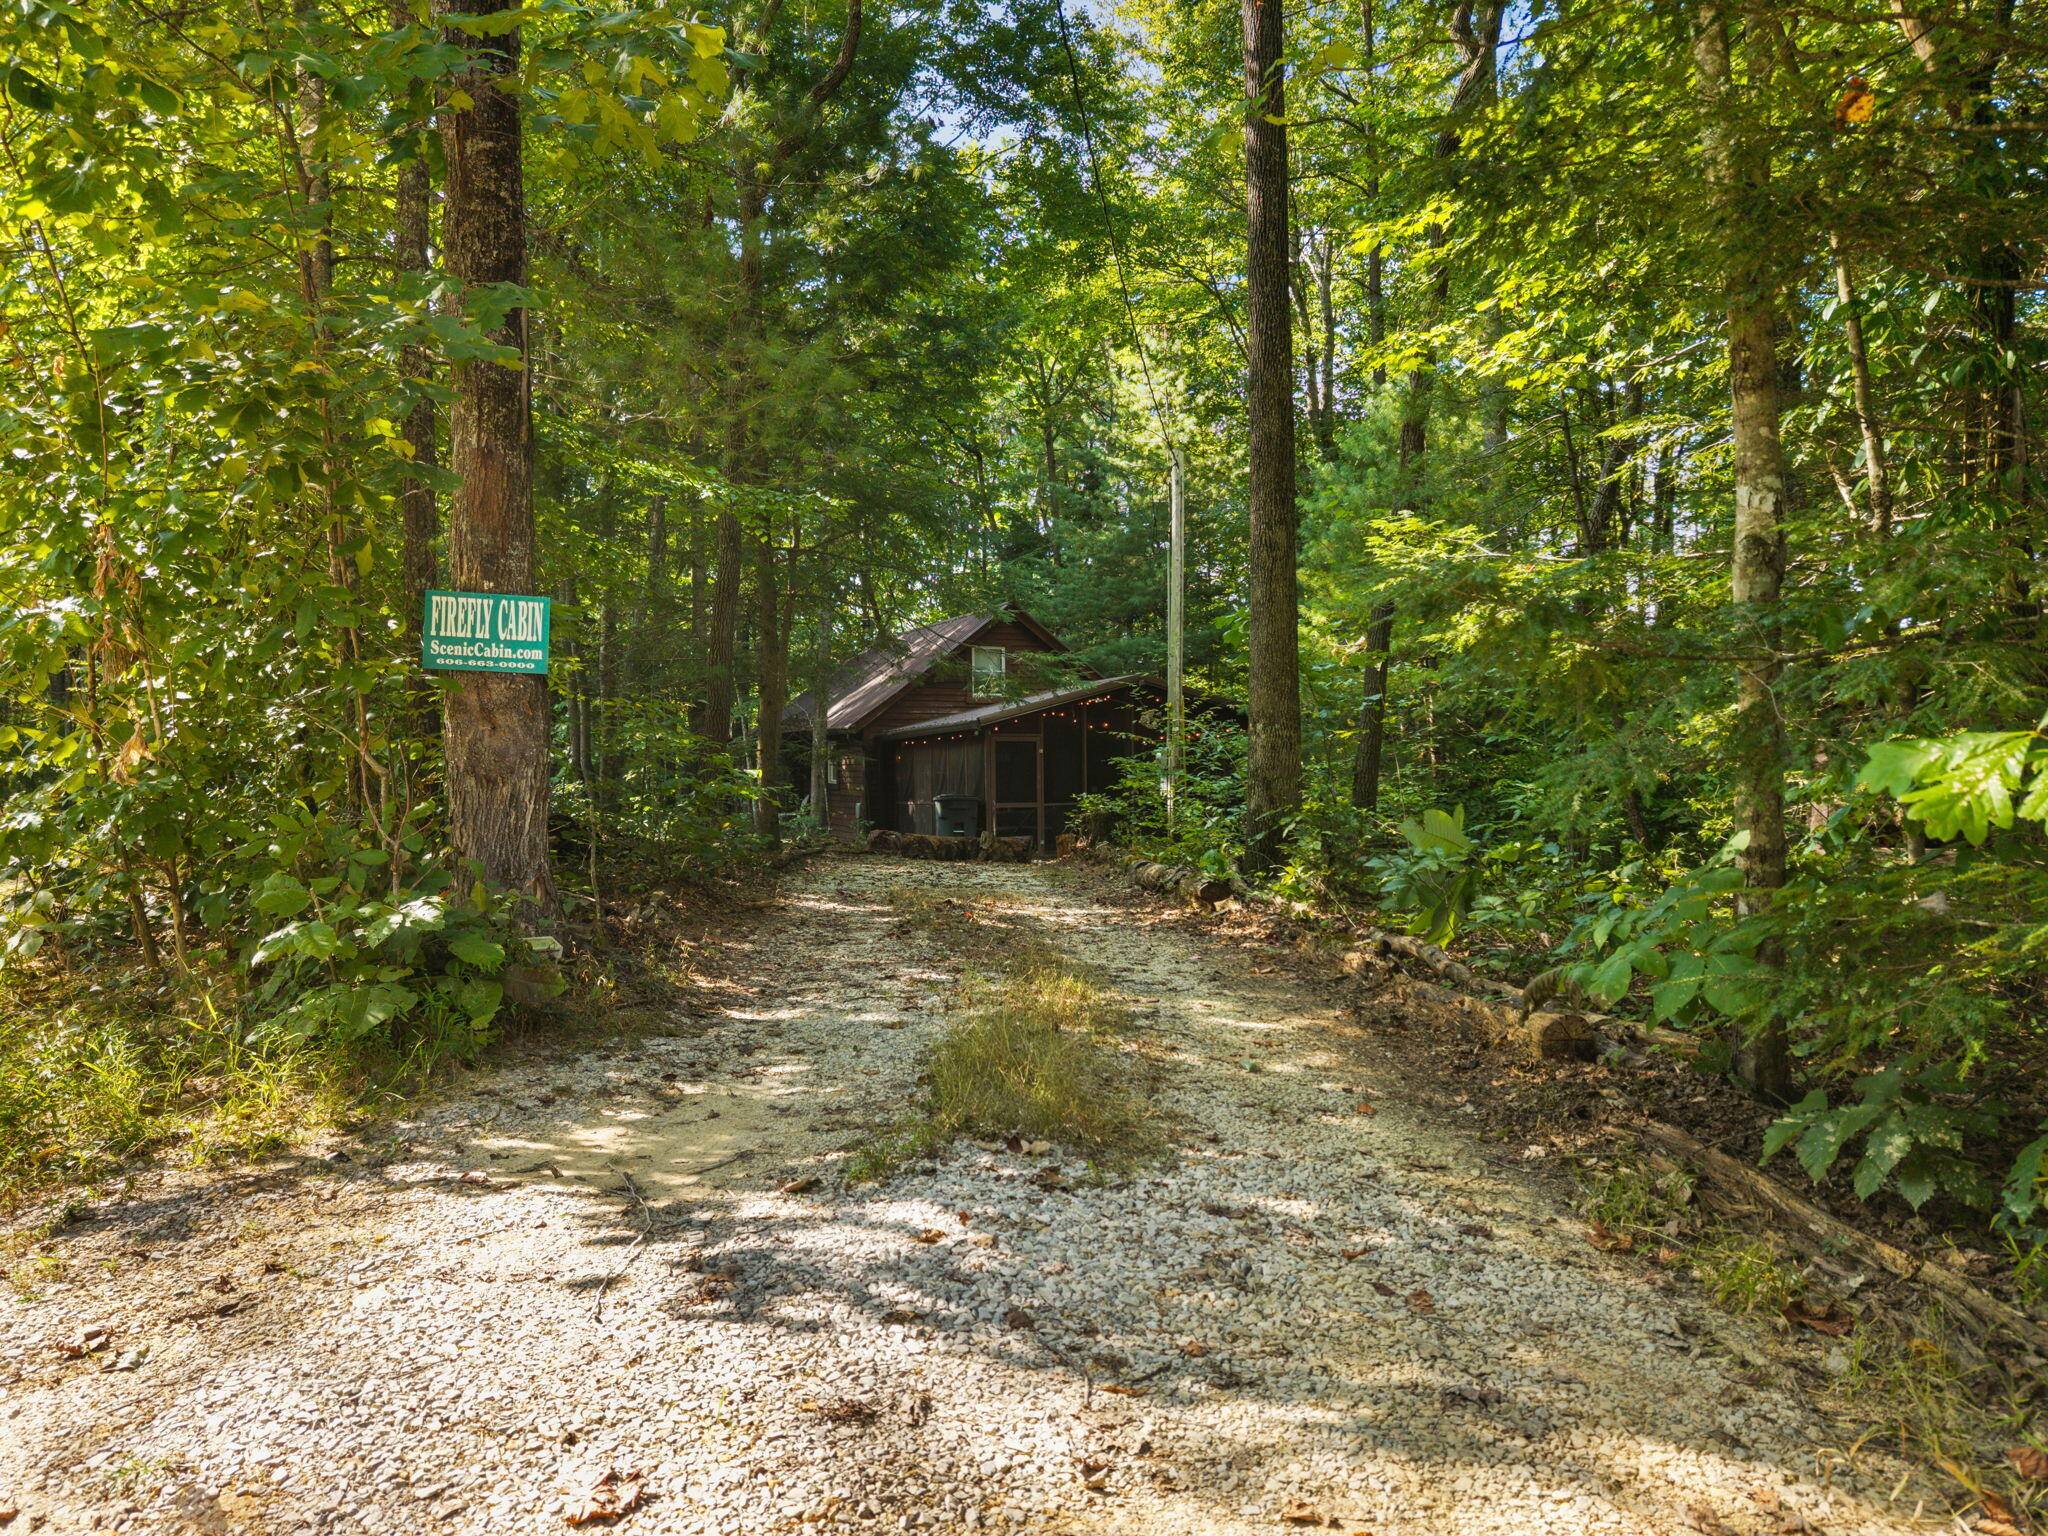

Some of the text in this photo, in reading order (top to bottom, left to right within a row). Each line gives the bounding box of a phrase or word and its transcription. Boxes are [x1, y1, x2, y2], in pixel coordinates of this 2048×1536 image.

[430, 596, 544, 642] FIREFLY CABIN
[430, 640, 543, 660] ScenicCabin.com
[436, 658, 535, 669] 606-663-0000
